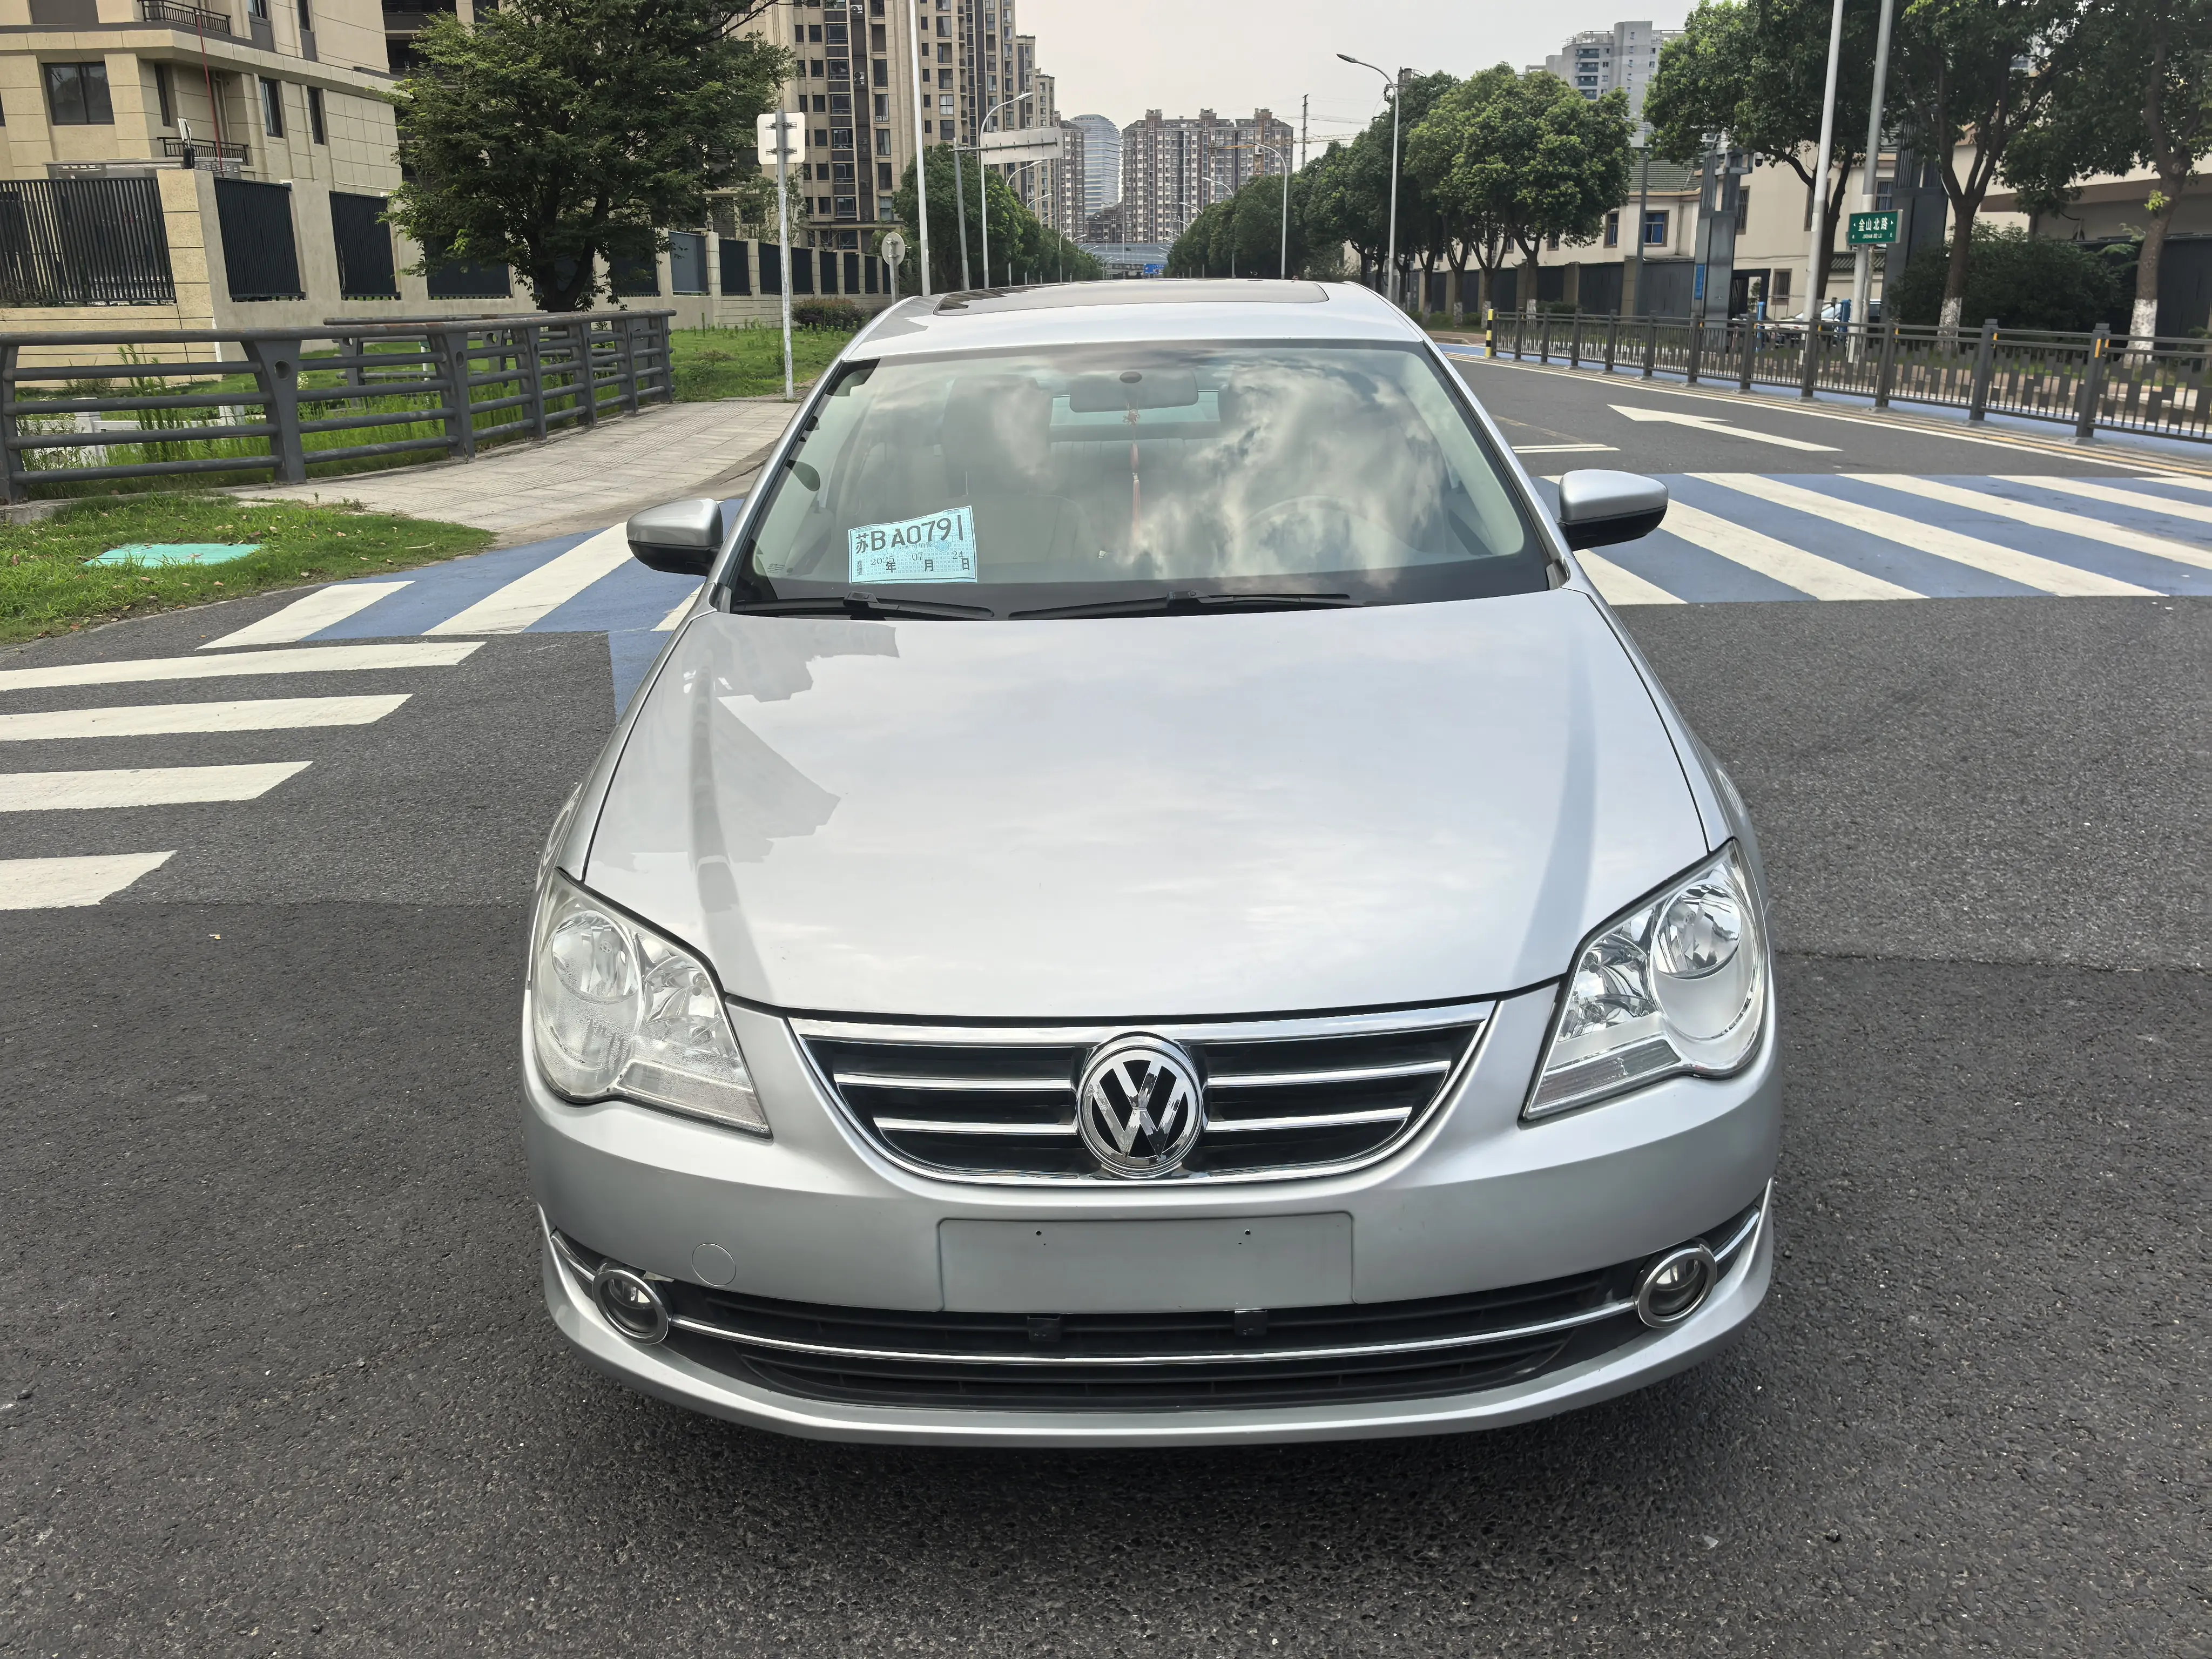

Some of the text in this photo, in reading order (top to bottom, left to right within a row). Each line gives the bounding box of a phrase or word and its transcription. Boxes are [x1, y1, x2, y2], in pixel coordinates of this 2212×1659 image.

[1858, 217, 1888, 231] 金山北路
[886, 561, 896, 573] 年
[912, 552, 923, 561] 07
[924, 559, 934, 572] 月
[961, 557, 970, 571] 日
